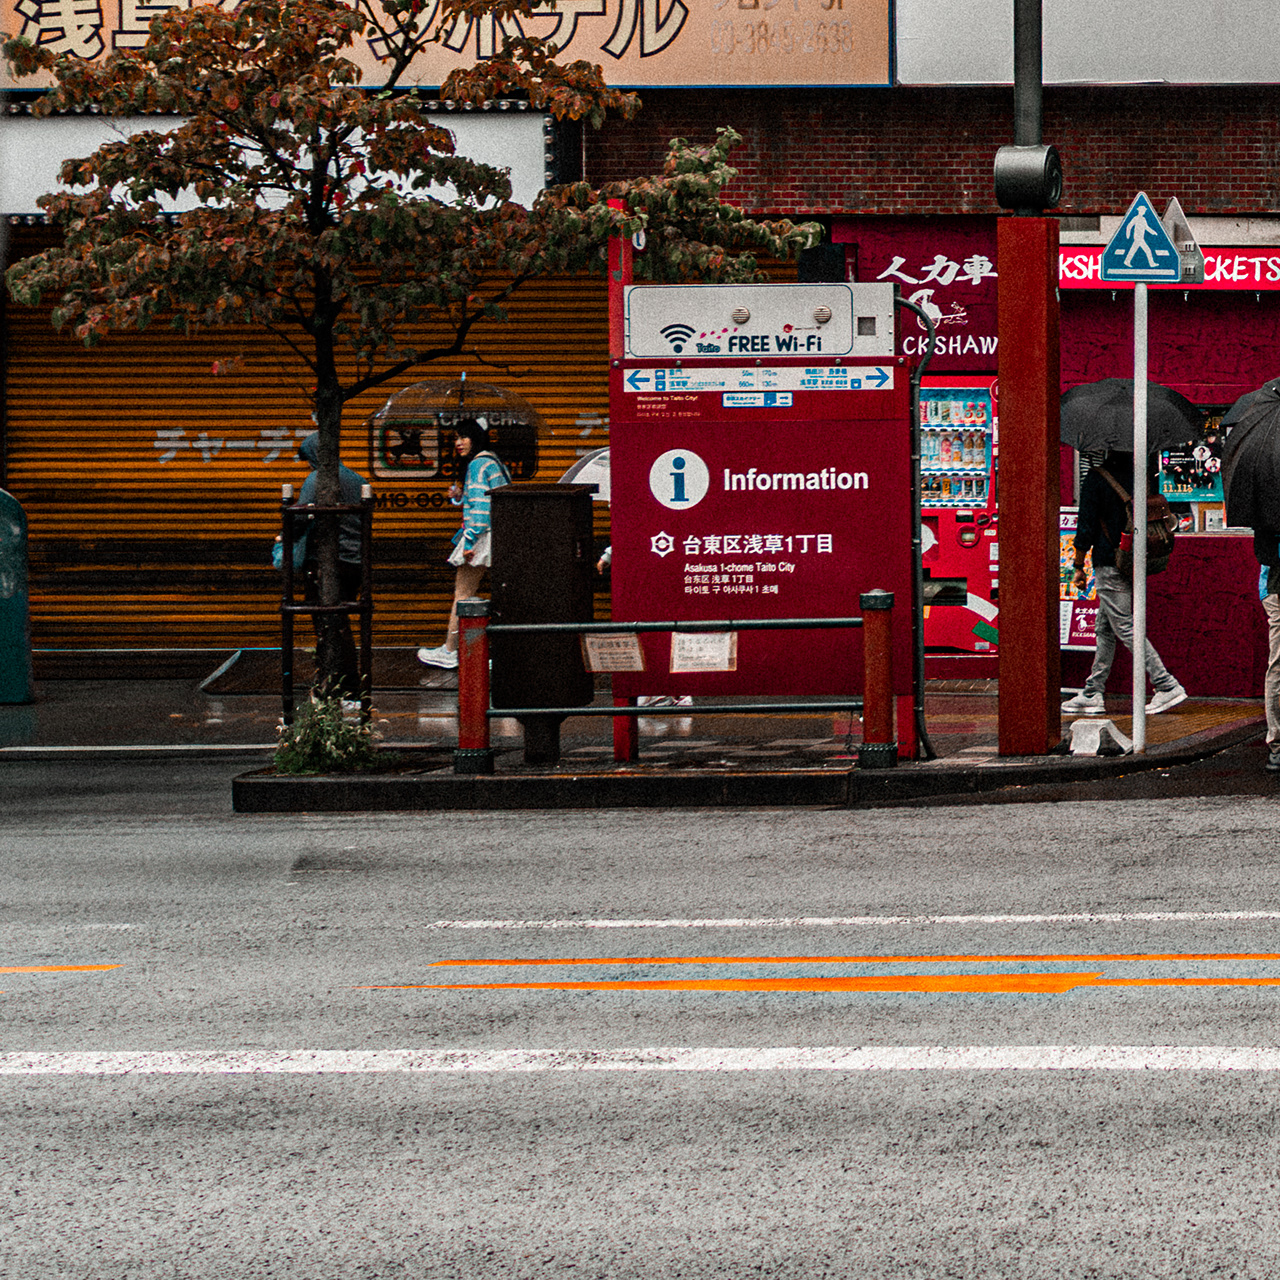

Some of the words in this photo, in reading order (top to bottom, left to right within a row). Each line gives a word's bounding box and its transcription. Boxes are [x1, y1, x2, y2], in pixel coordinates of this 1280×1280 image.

[876, 254, 998, 285] 人力車
[728, 335, 770, 352] FREE
[775, 335, 822, 352] Wi-Fi
[903, 335, 998, 355] CKSHAW
[724, 468, 869, 490] Information
[682, 534, 834, 555] 台東区浅草1丁目
[684, 563, 718, 572] Asakusa
[720, 562, 754, 572] 1-chome
[755, 562, 776, 572] Taito
[778, 561, 795, 573] City
